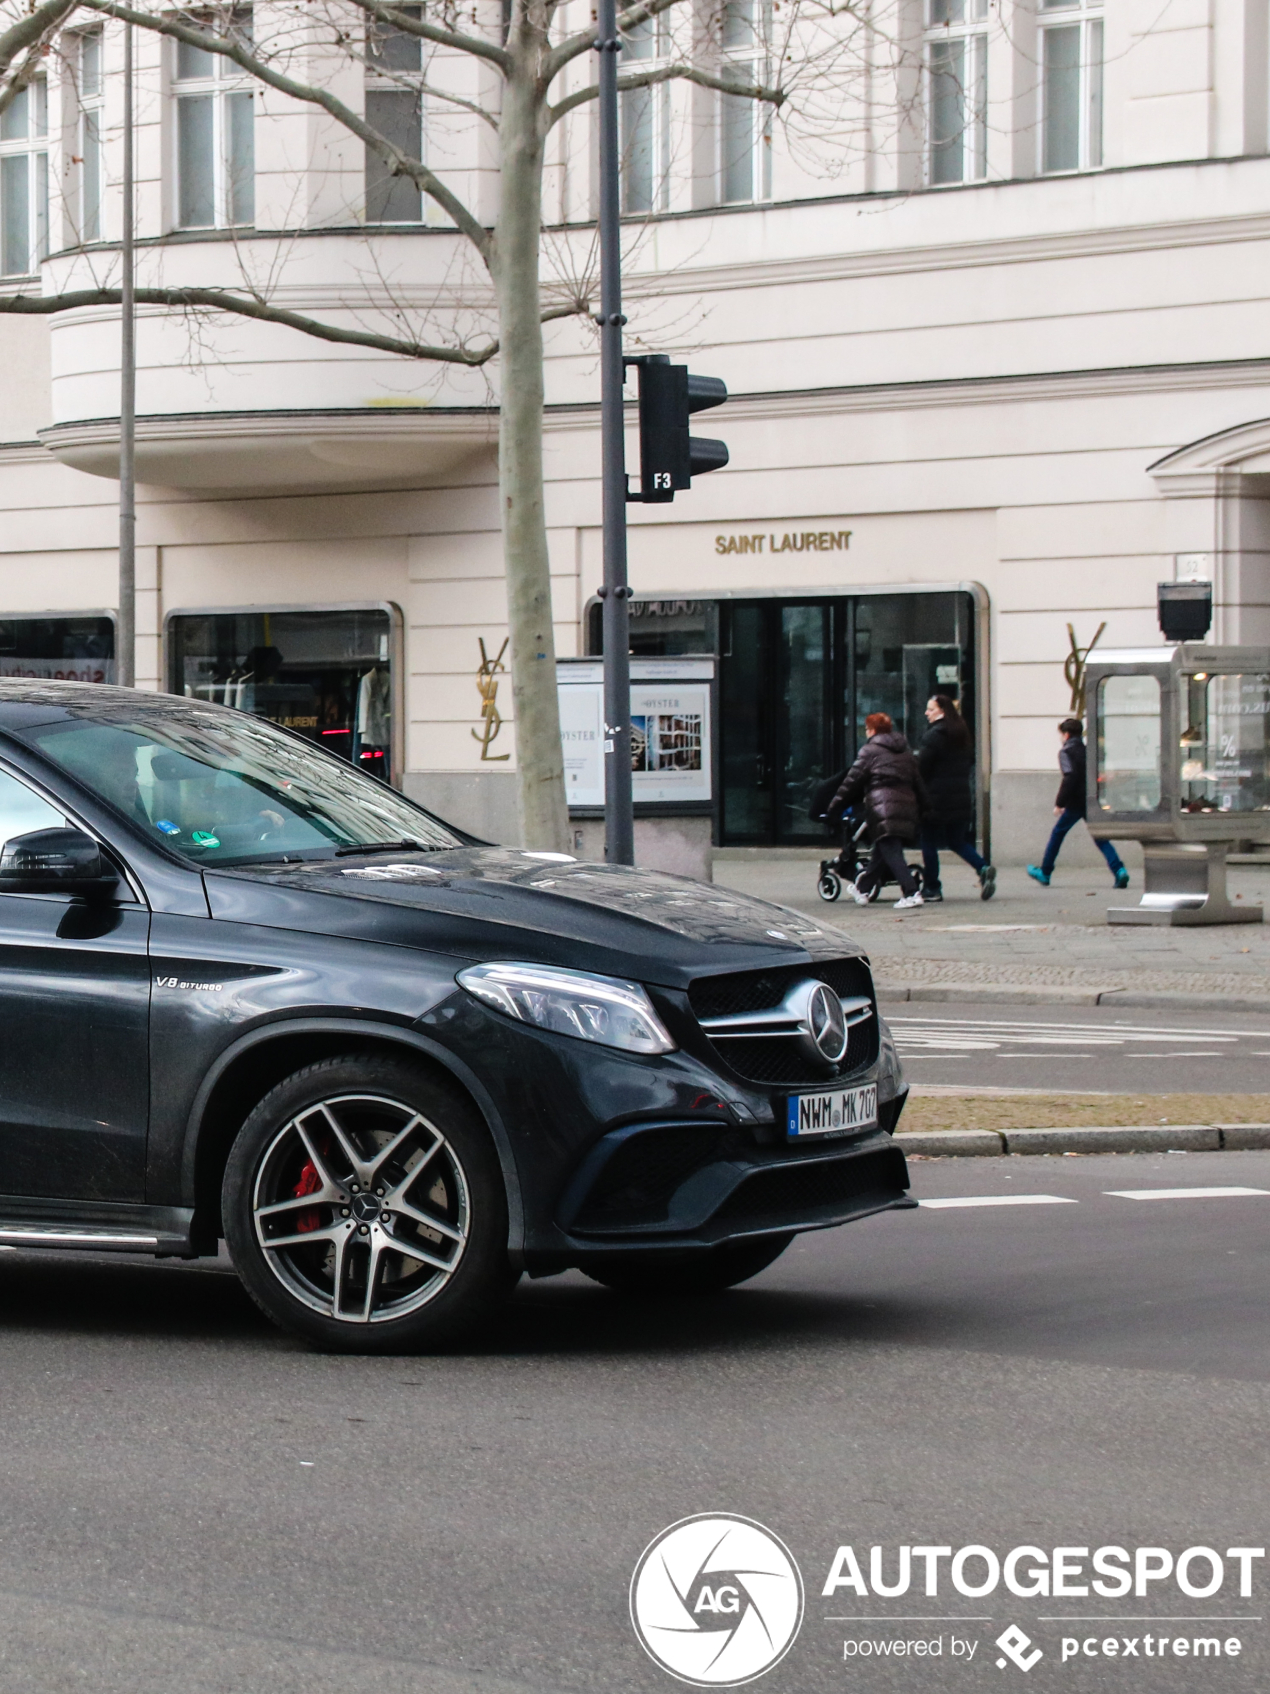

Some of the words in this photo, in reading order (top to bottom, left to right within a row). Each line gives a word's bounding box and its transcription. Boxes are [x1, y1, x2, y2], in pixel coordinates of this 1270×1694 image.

[654, 472, 672, 489] F3
[715, 534, 766, 555] SAINT
[770, 531, 852, 553] LAURENT
[156, 976, 178, 988] V8
[800, 1096, 831, 1131] NWM
[842, 1092, 857, 1124] MK
[790, 1120, 795, 1129] D
